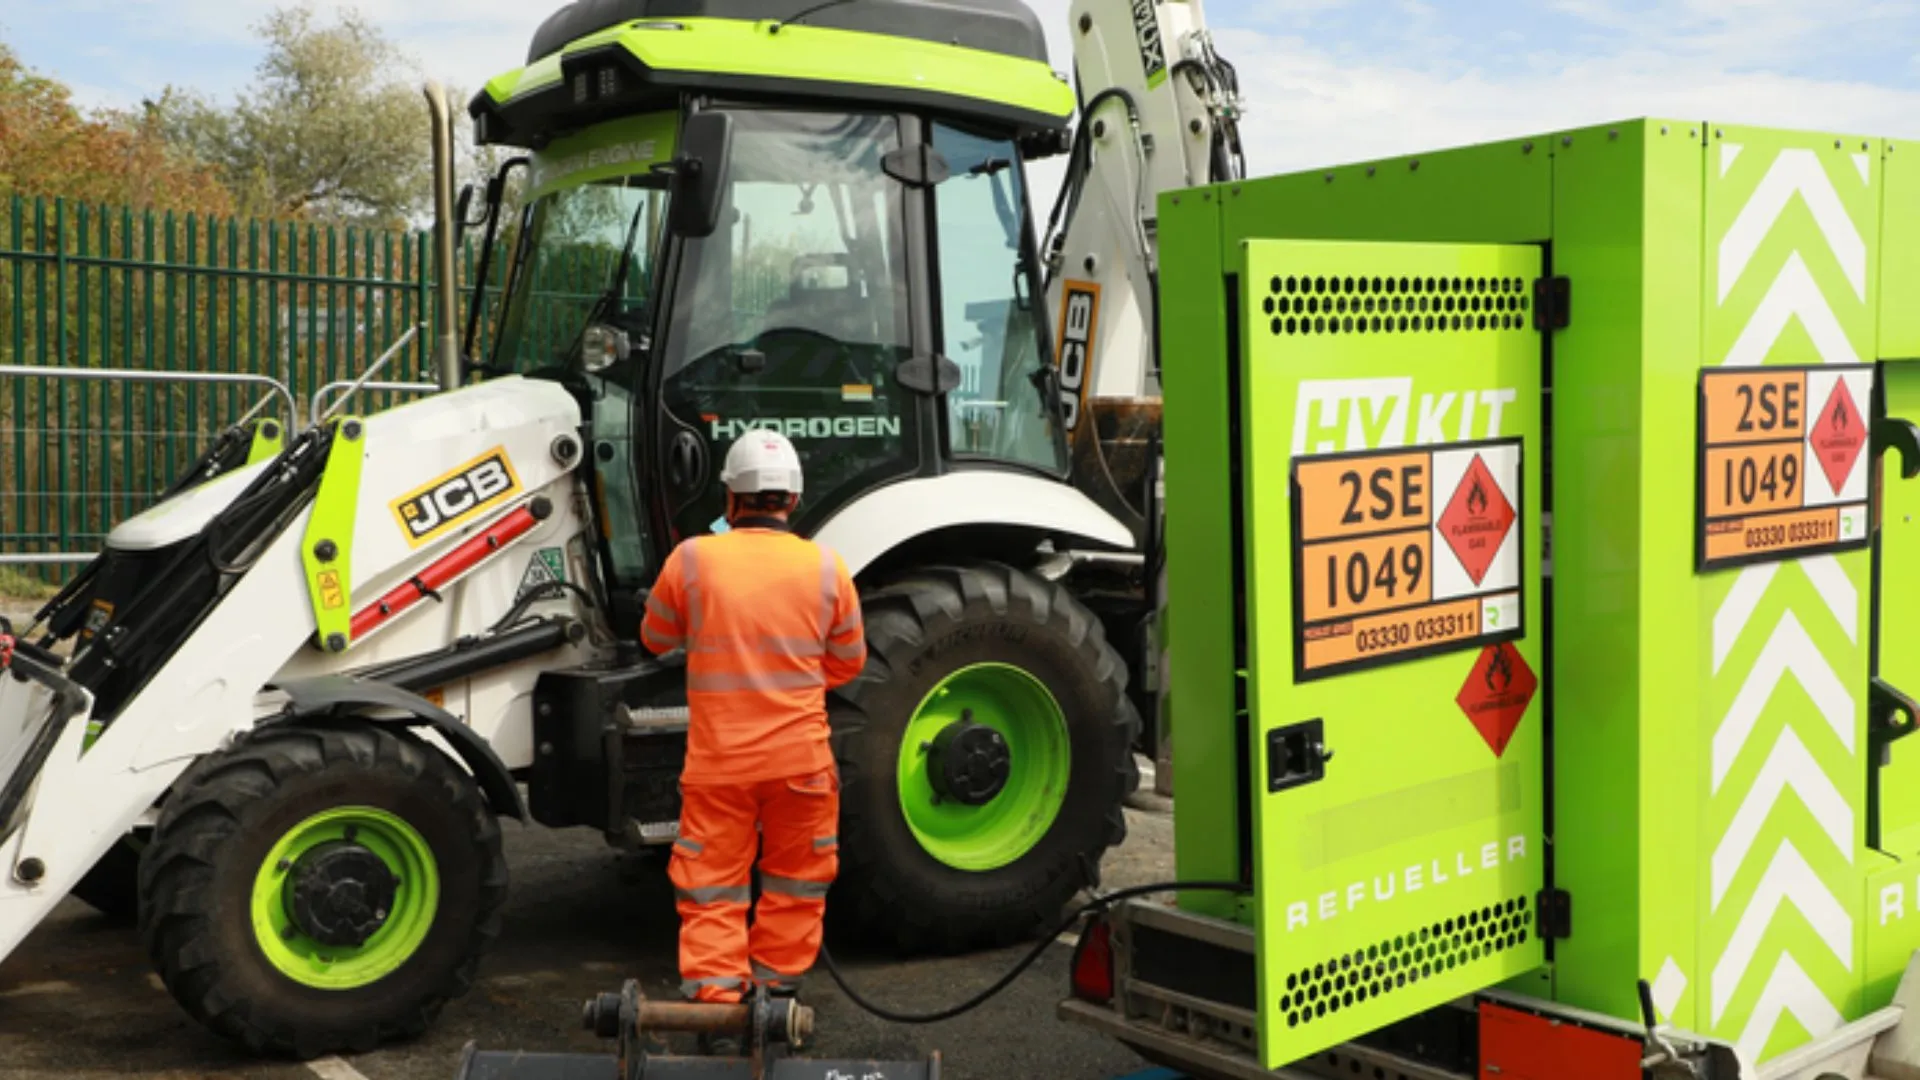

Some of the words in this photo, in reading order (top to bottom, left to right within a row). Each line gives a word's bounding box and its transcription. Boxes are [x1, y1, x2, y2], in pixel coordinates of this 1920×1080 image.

[1060, 293, 1091, 429] JCB
[1736, 381, 1800, 432] 2SE
[402, 460, 510, 534] JCB
[1339, 465, 1423, 525] 2SE
[1725, 453, 1798, 506] 1049
[1745, 524, 1785, 548] 03330
[1327, 543, 1424, 608] 1049
[1356, 623, 1411, 652] 03330
[1414, 611, 1475, 641] 033311
[1286, 834, 1527, 932] REFUELLER
[1880, 874, 1920, 927] R
